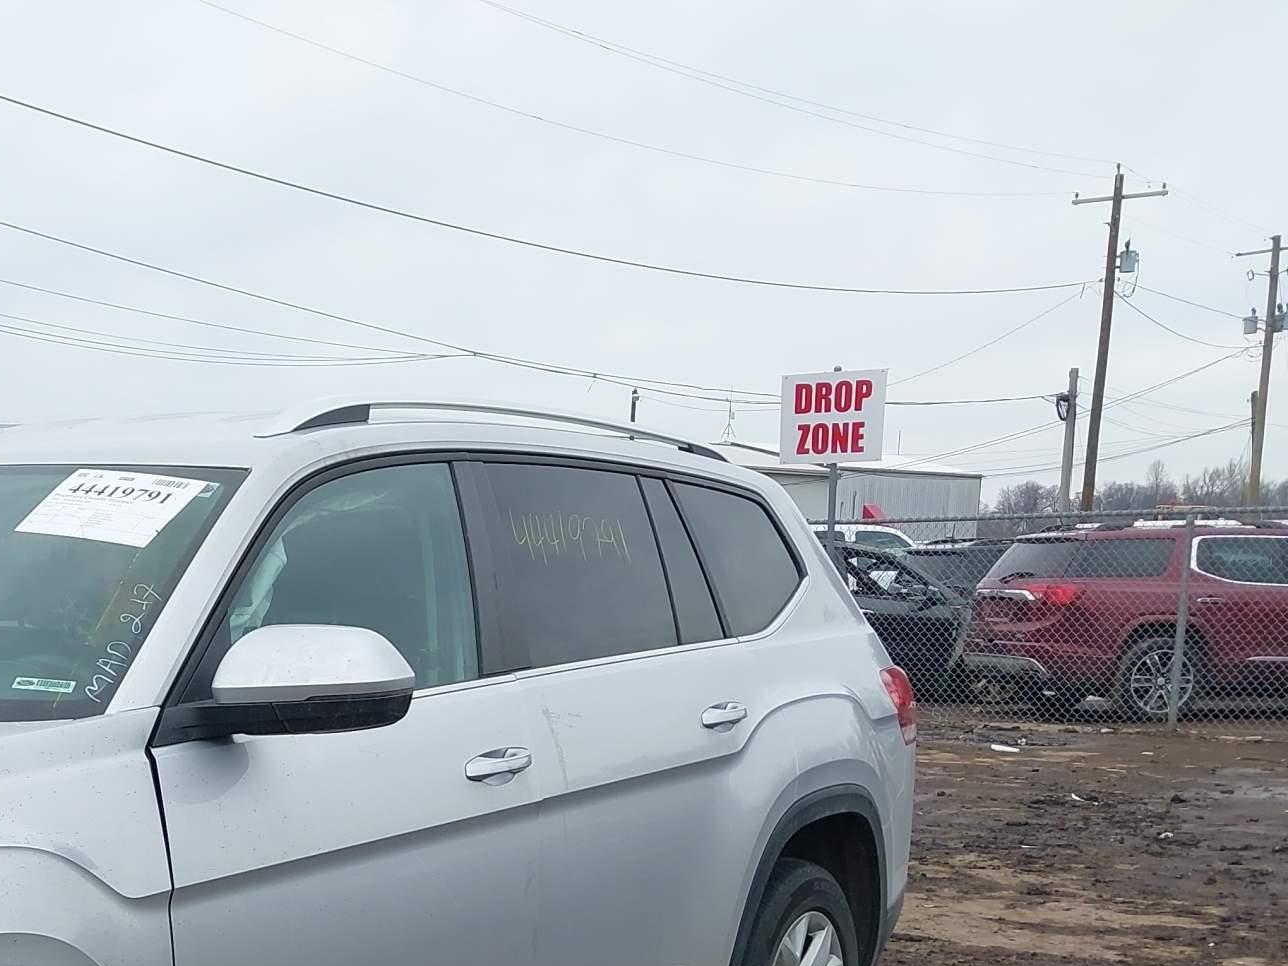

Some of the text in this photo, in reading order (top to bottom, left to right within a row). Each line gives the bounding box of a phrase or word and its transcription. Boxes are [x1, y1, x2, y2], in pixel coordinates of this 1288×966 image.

[794, 379, 873, 414] DROP
[796, 421, 865, 455] ZONE
[68, 482, 173, 504] 44419791
[84, 641, 132, 703] MAD
